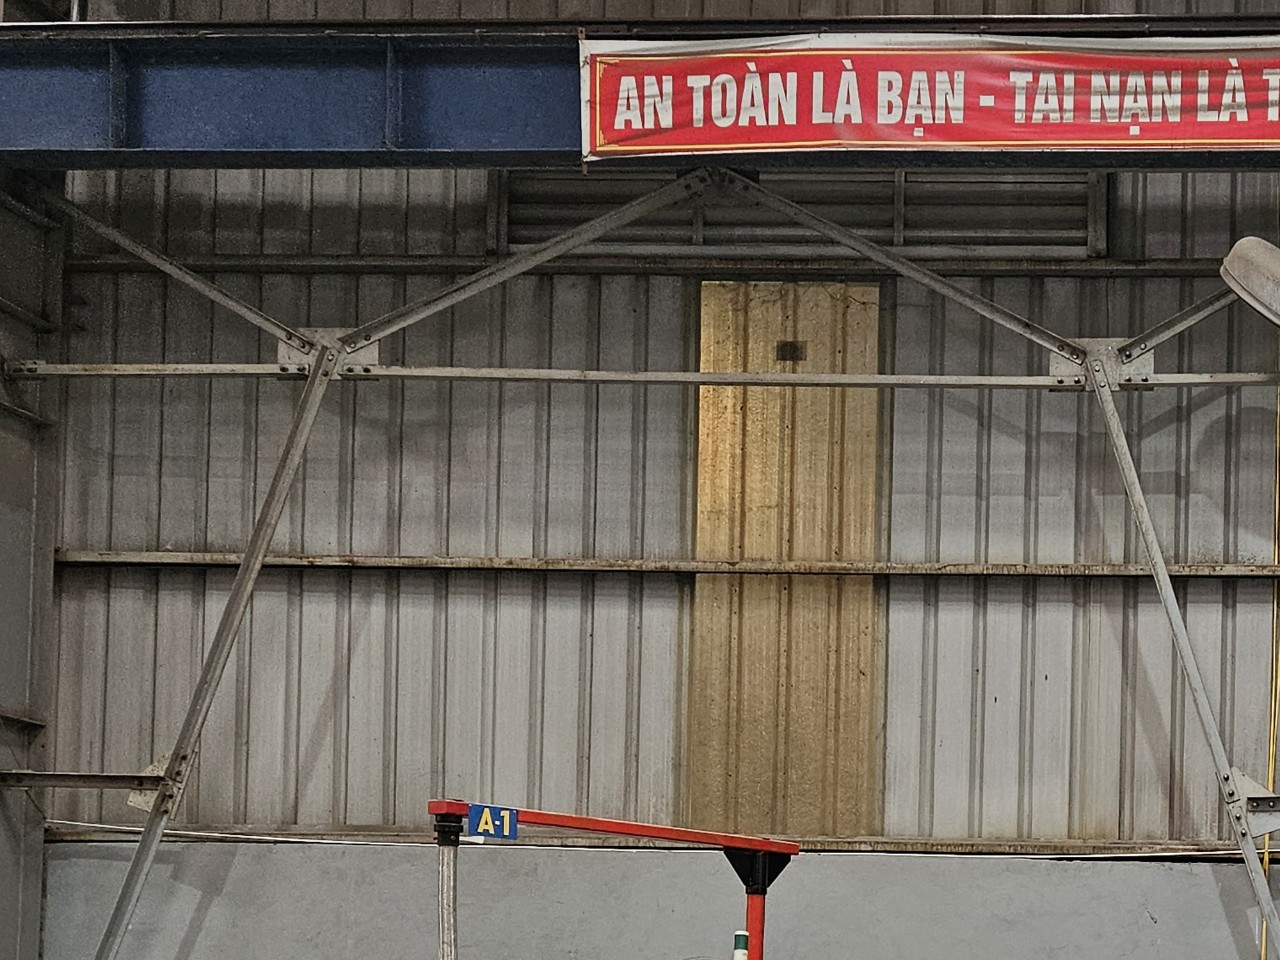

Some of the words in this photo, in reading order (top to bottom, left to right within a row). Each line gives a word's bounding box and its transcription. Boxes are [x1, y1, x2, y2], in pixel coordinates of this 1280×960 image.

[614, 76, 673, 129] AN
[686, 58, 797, 127] TOÀN
[812, 59, 863, 128] LÀ
[875, 70, 966, 140] BẠN
[1008, 65, 1076, 123] TAI
[1088, 71, 1181, 136] NẠN
[1195, 54, 1250, 122] LÀ
[477, 808, 509, 836] A-1
